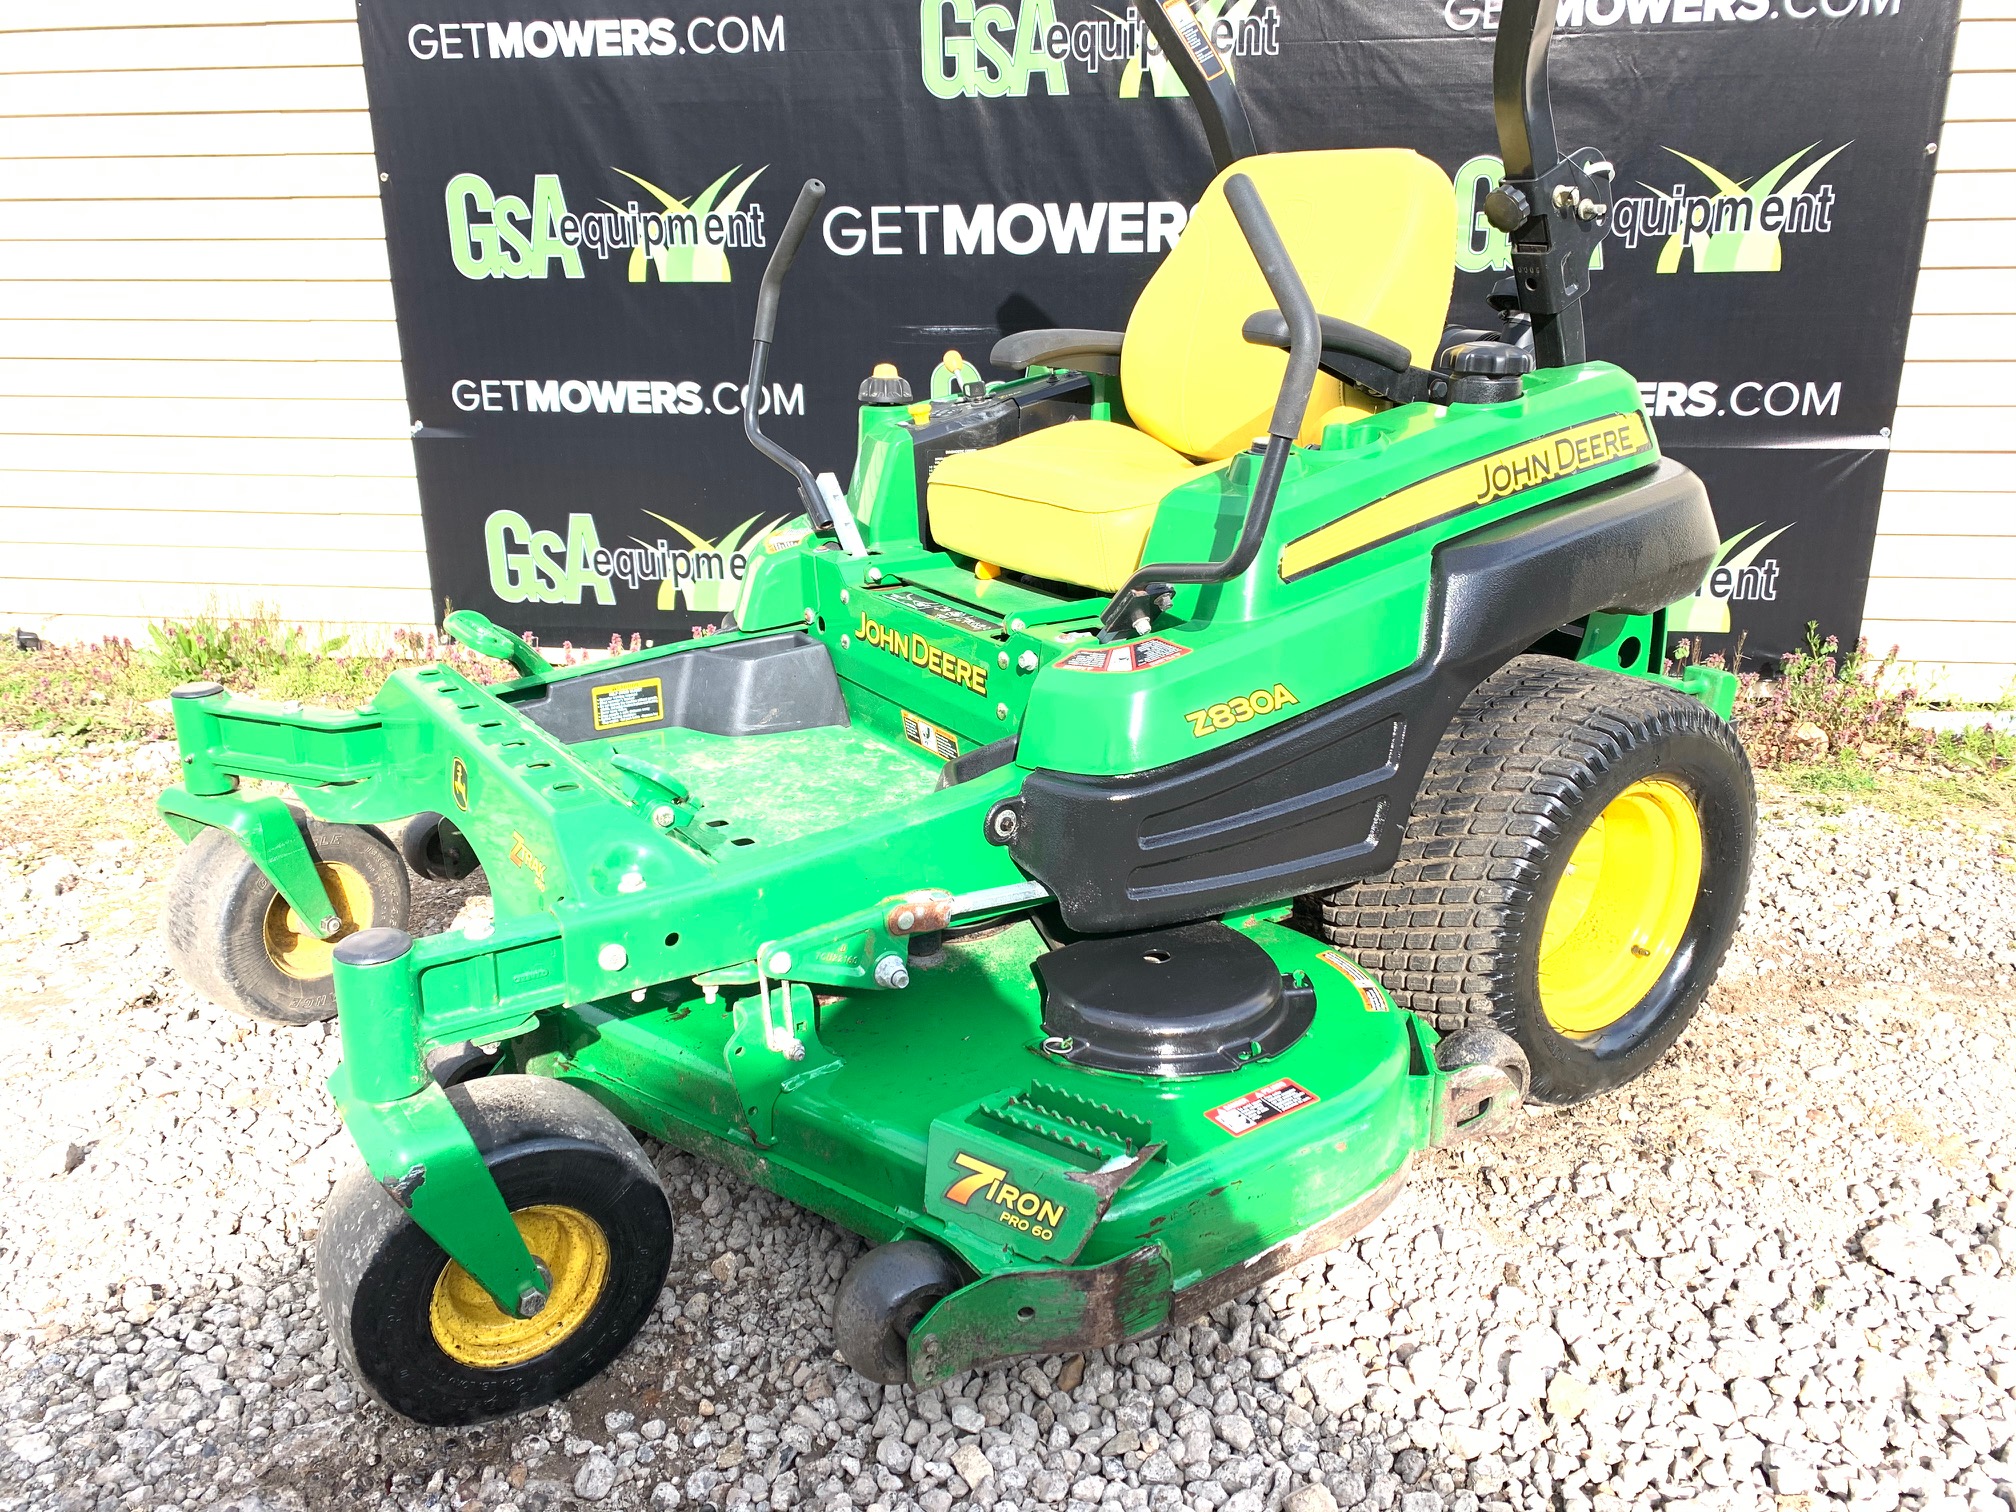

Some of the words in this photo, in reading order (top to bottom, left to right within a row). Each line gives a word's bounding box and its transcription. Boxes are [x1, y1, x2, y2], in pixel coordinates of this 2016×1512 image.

[408, 14, 787, 60] GETMOWERS.COM
[1046, 6, 1281, 73] equipent
[558, 201, 767, 260] equipment
[822, 200, 1200, 256] GETMOWER
[1611, 184, 1835, 248] quipment
[451, 378, 805, 416] GETMOWERS.COM
[1477, 450, 1551, 500] JOHN
[1555, 426, 1634, 471] DEERE
[591, 539, 748, 590] equipme
[855, 611, 909, 663] JOHN
[912, 632, 988, 698] DEERE
[1184, 683, 1300, 738] Z830A
[1000, 1211, 1029, 1231] PRO
[1031, 1225, 1053, 1241] 60
